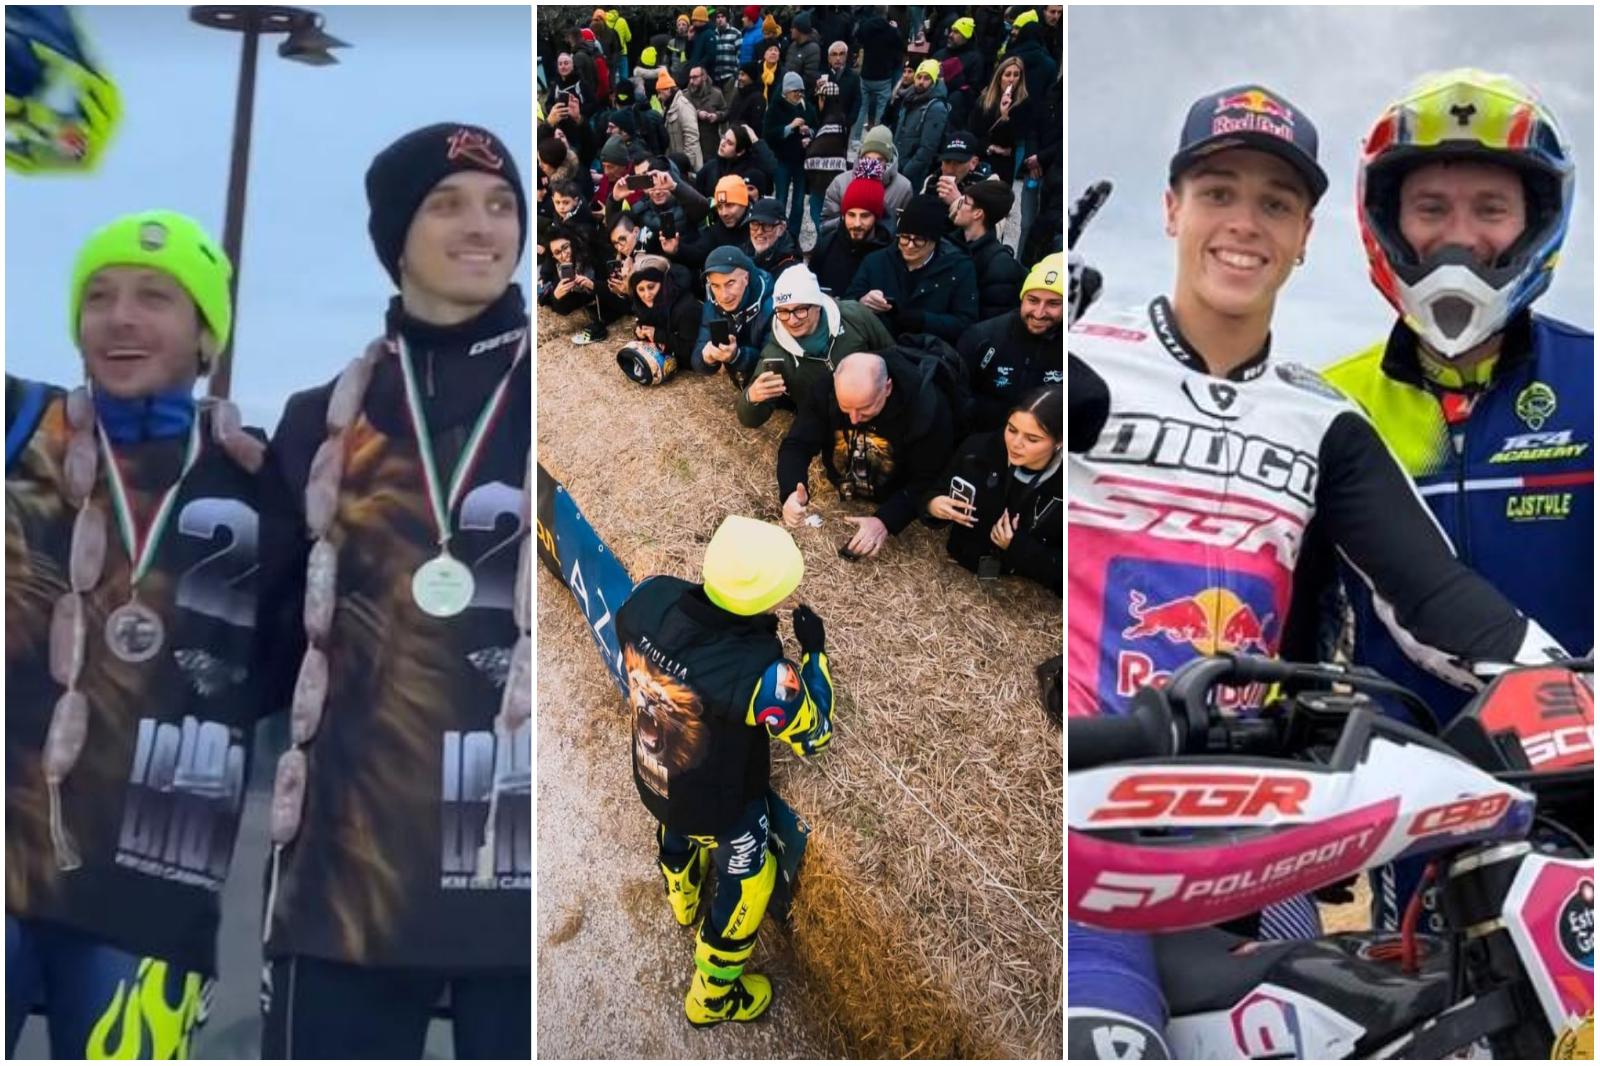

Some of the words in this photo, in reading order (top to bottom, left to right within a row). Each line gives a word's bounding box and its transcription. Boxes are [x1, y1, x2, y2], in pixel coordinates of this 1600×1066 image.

[1212, 110, 1253, 136] Red
[1489, 442, 1589, 464] ACADEMY
[1068, 474, 1305, 572] SGR
[1506, 493, 1572, 518] CJSTYLE
[1117, 650, 1173, 697] Re
[1087, 773, 1312, 823] SGR
[1182, 827, 1375, 903] POLISPORT
